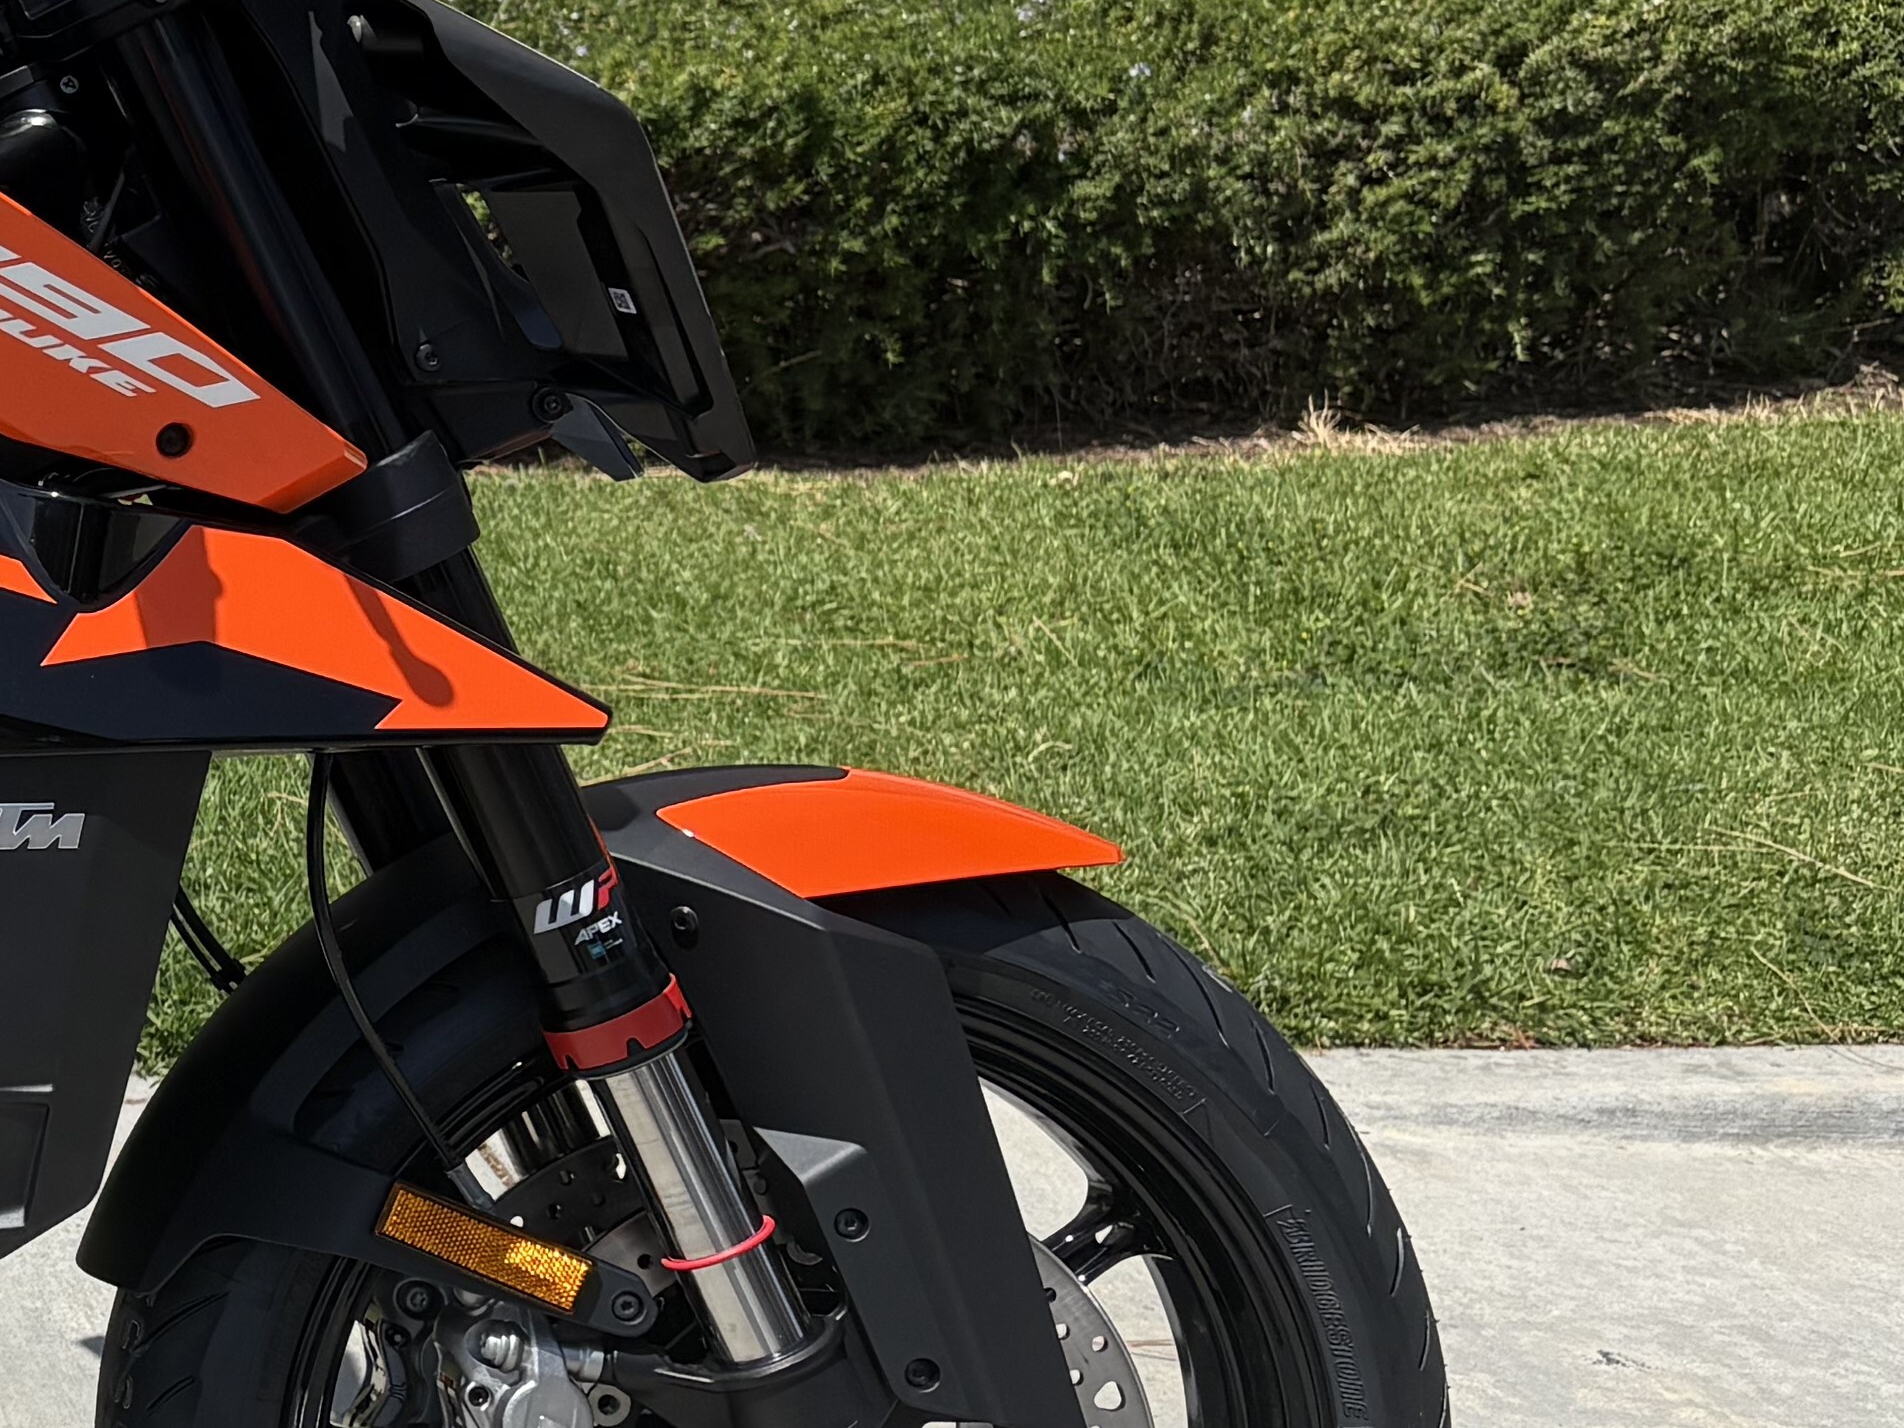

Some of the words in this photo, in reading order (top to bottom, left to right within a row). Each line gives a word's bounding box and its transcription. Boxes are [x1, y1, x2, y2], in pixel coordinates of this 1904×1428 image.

[533, 866, 620, 935] WP
[574, 910, 623, 946] APEX
[1274, 1208, 1369, 1422] BRIDGESTONE
